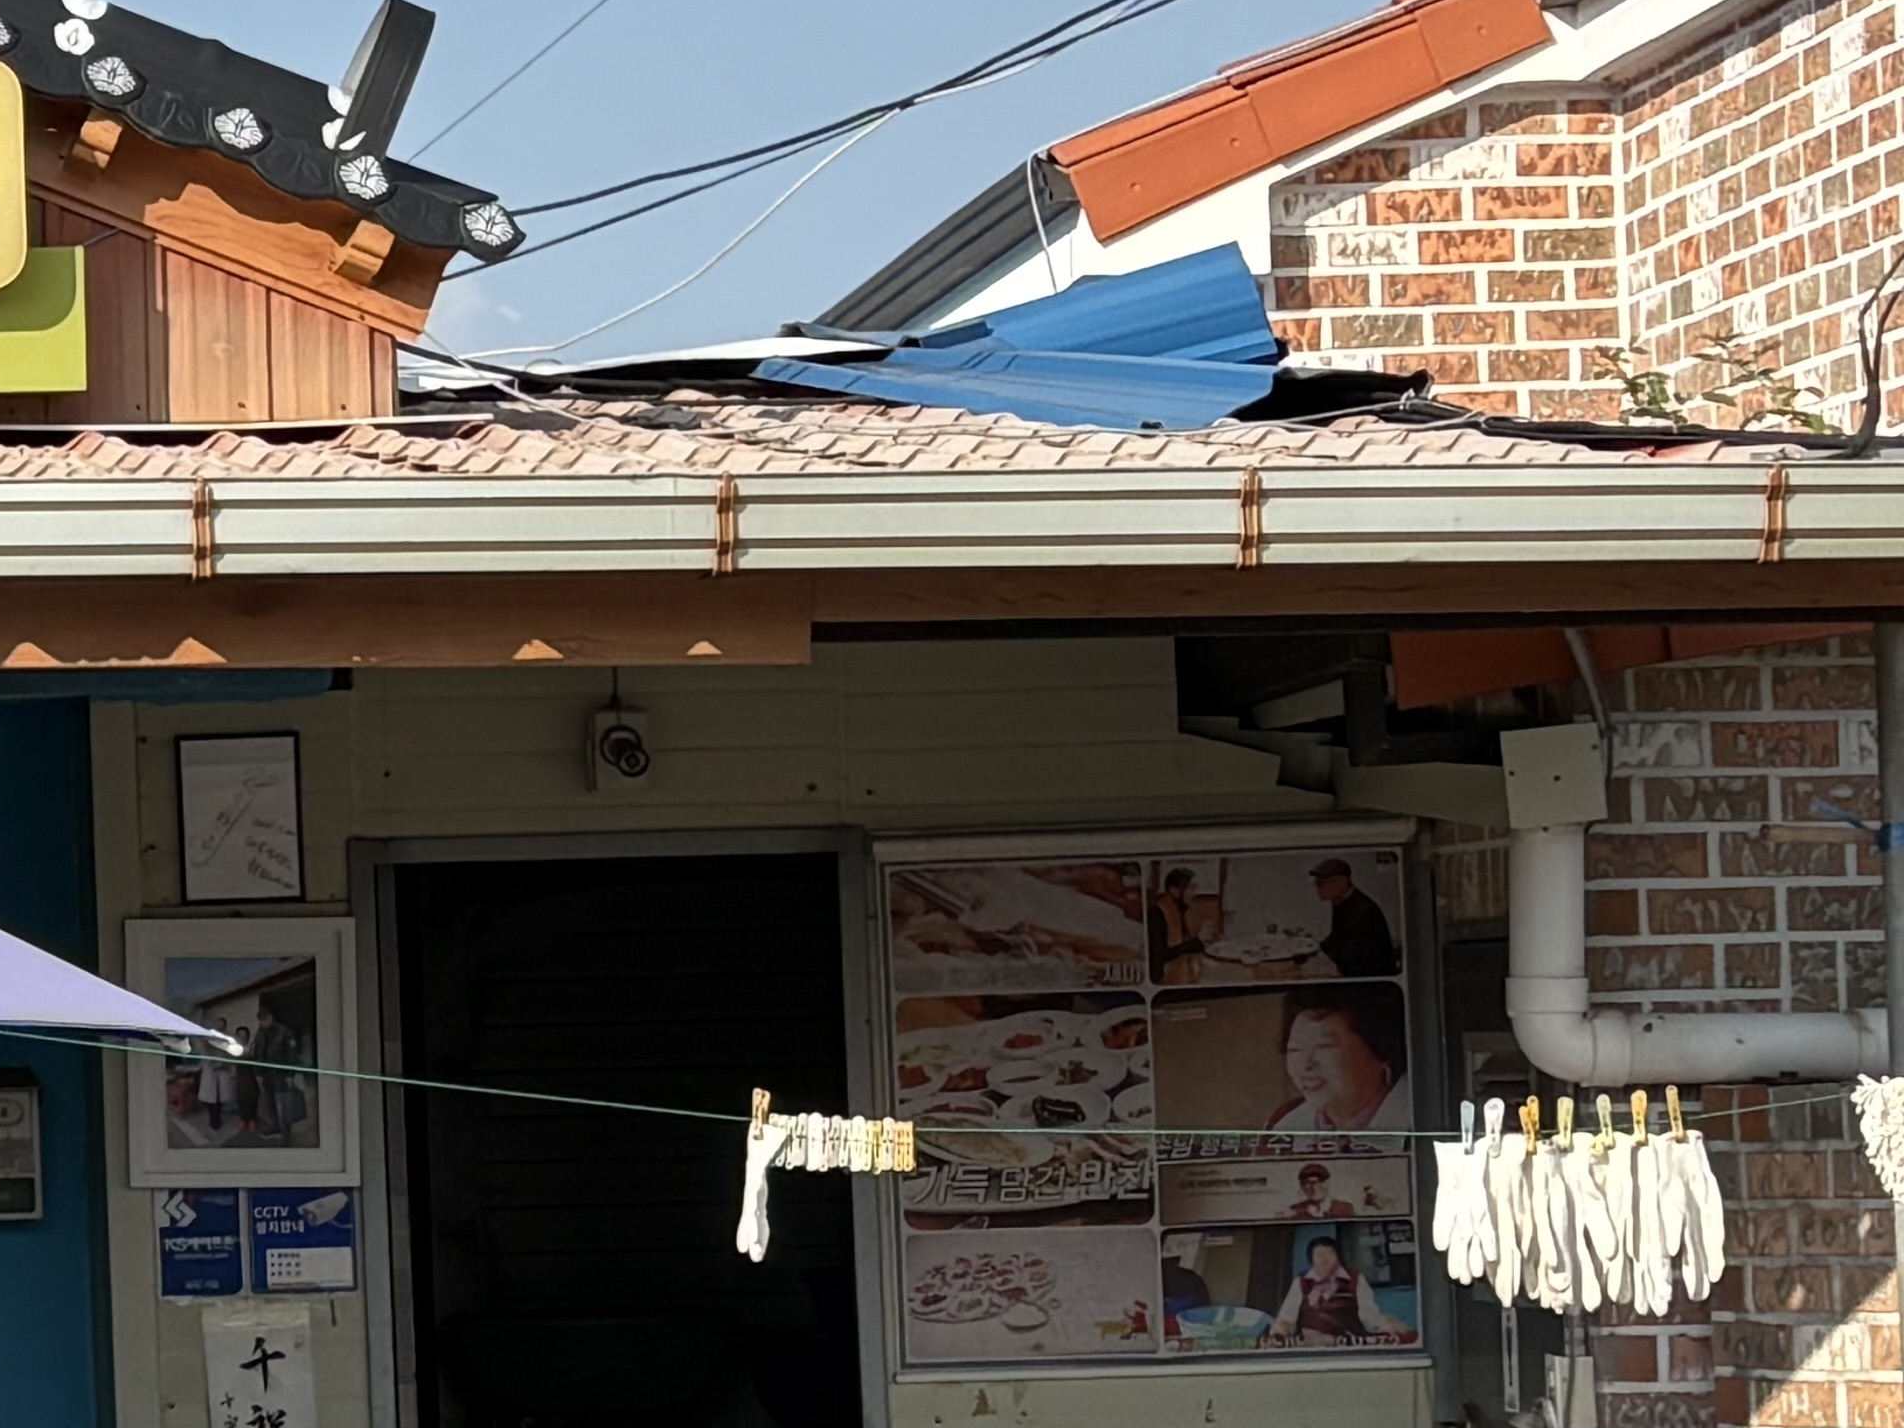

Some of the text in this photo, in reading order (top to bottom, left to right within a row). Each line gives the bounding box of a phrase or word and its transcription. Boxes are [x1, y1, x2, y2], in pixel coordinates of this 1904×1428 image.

[914, 1163, 989, 1205] 가득
[1081, 1159, 1151, 1201] 반찬
[254, 1206, 289, 1220] CCTV
